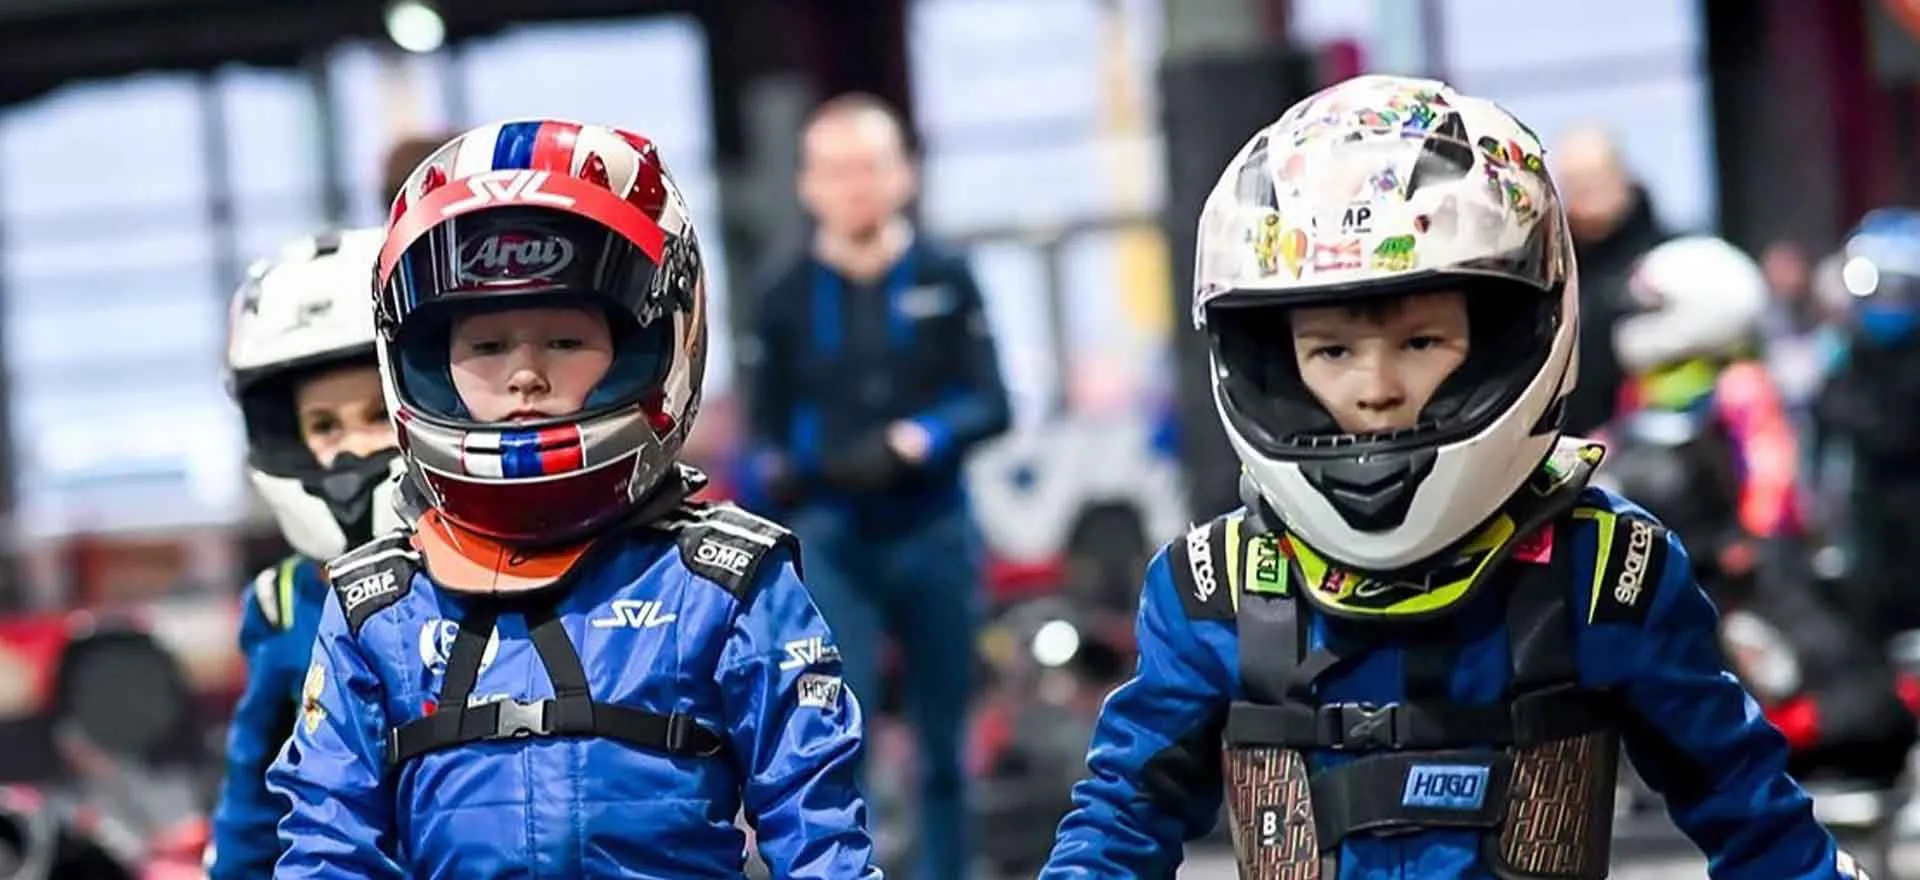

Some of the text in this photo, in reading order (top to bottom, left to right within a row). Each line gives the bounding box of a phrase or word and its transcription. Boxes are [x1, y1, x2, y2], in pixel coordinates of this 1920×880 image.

[441, 171, 576, 216] SVL
[467, 234, 556, 269] Arai
[696, 543, 752, 574] OMP
[1614, 521, 1653, 606] sparco
[344, 570, 398, 606] OMP
[592, 600, 677, 628] SVL
[1413, 773, 1479, 797] HOGO
